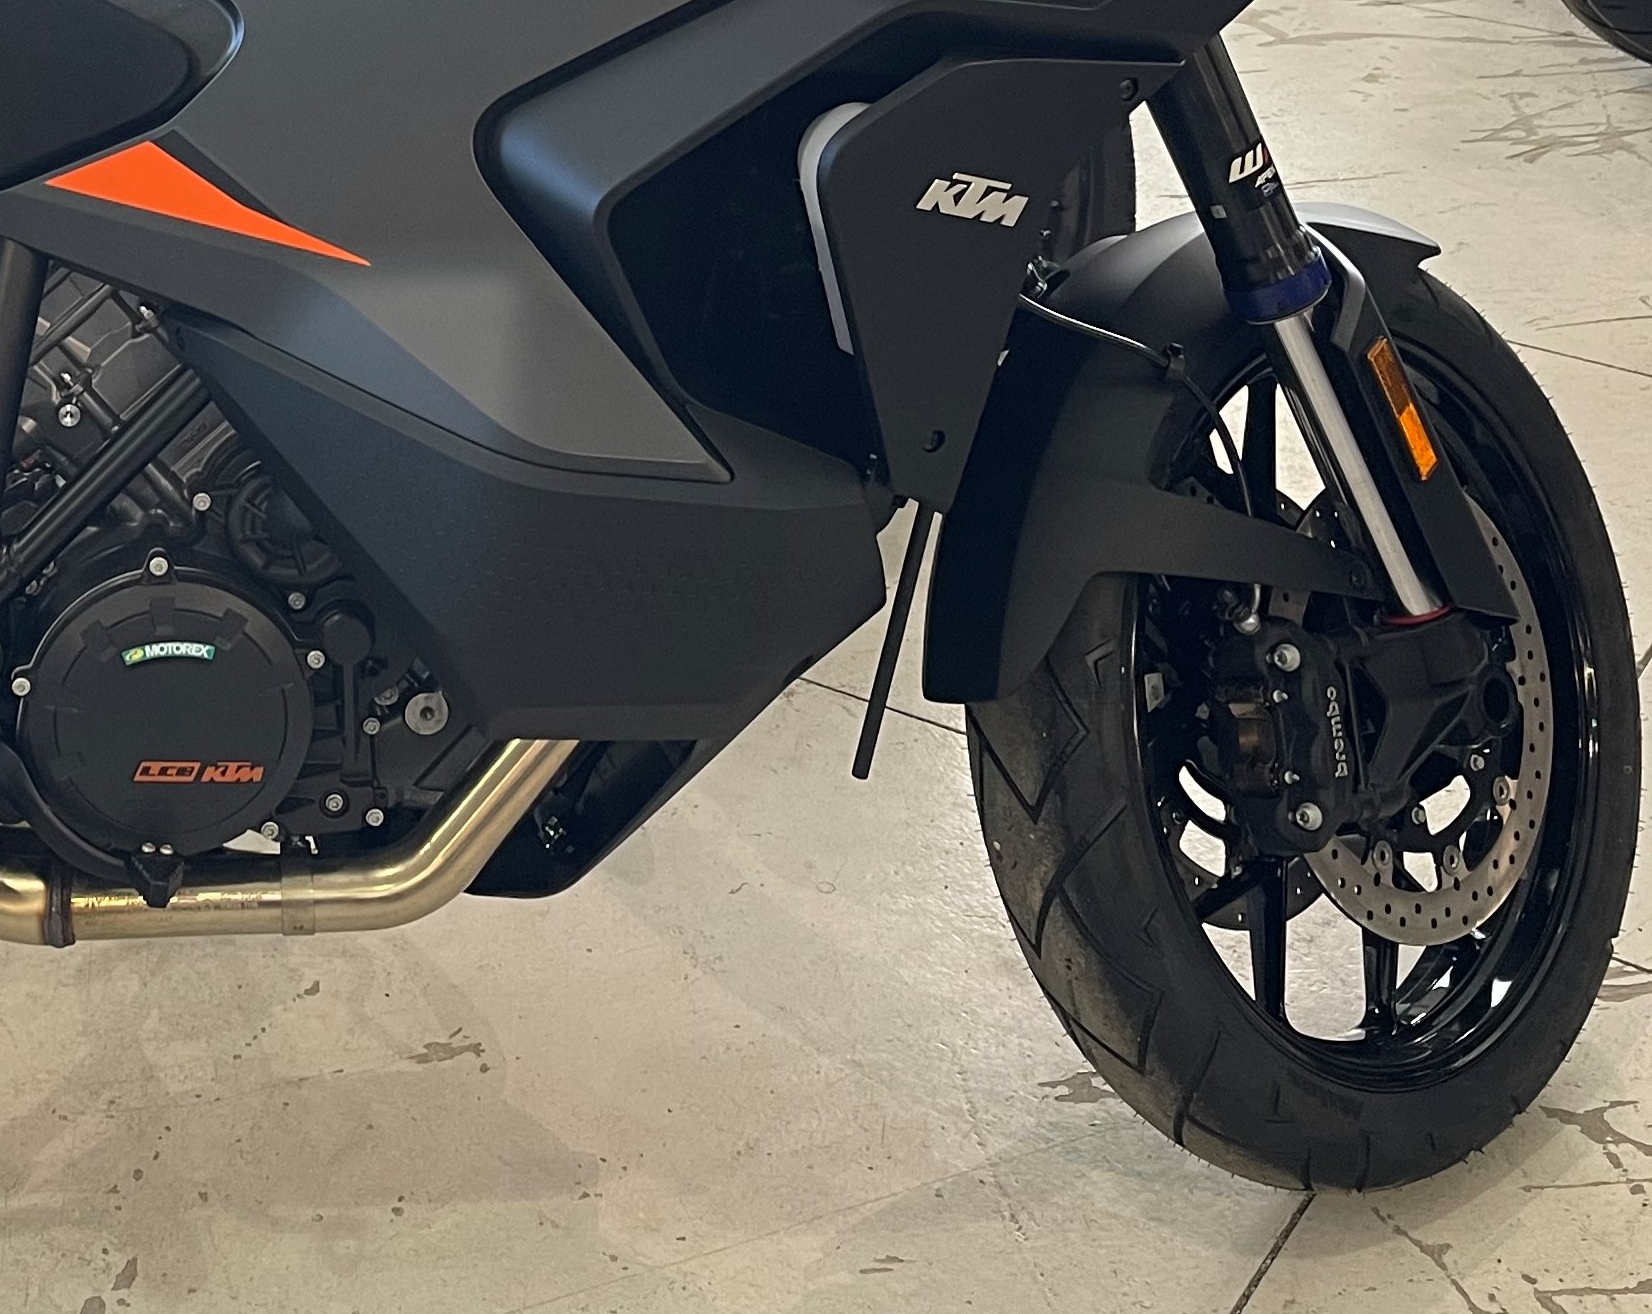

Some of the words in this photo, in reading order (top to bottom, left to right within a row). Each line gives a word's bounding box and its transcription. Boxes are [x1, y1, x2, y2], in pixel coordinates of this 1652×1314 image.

[915, 172, 1029, 227] KTM
[144, 641, 210, 659] MOTOREX
[1327, 686, 1349, 778] brembo
[200, 761, 265, 783] KTM
